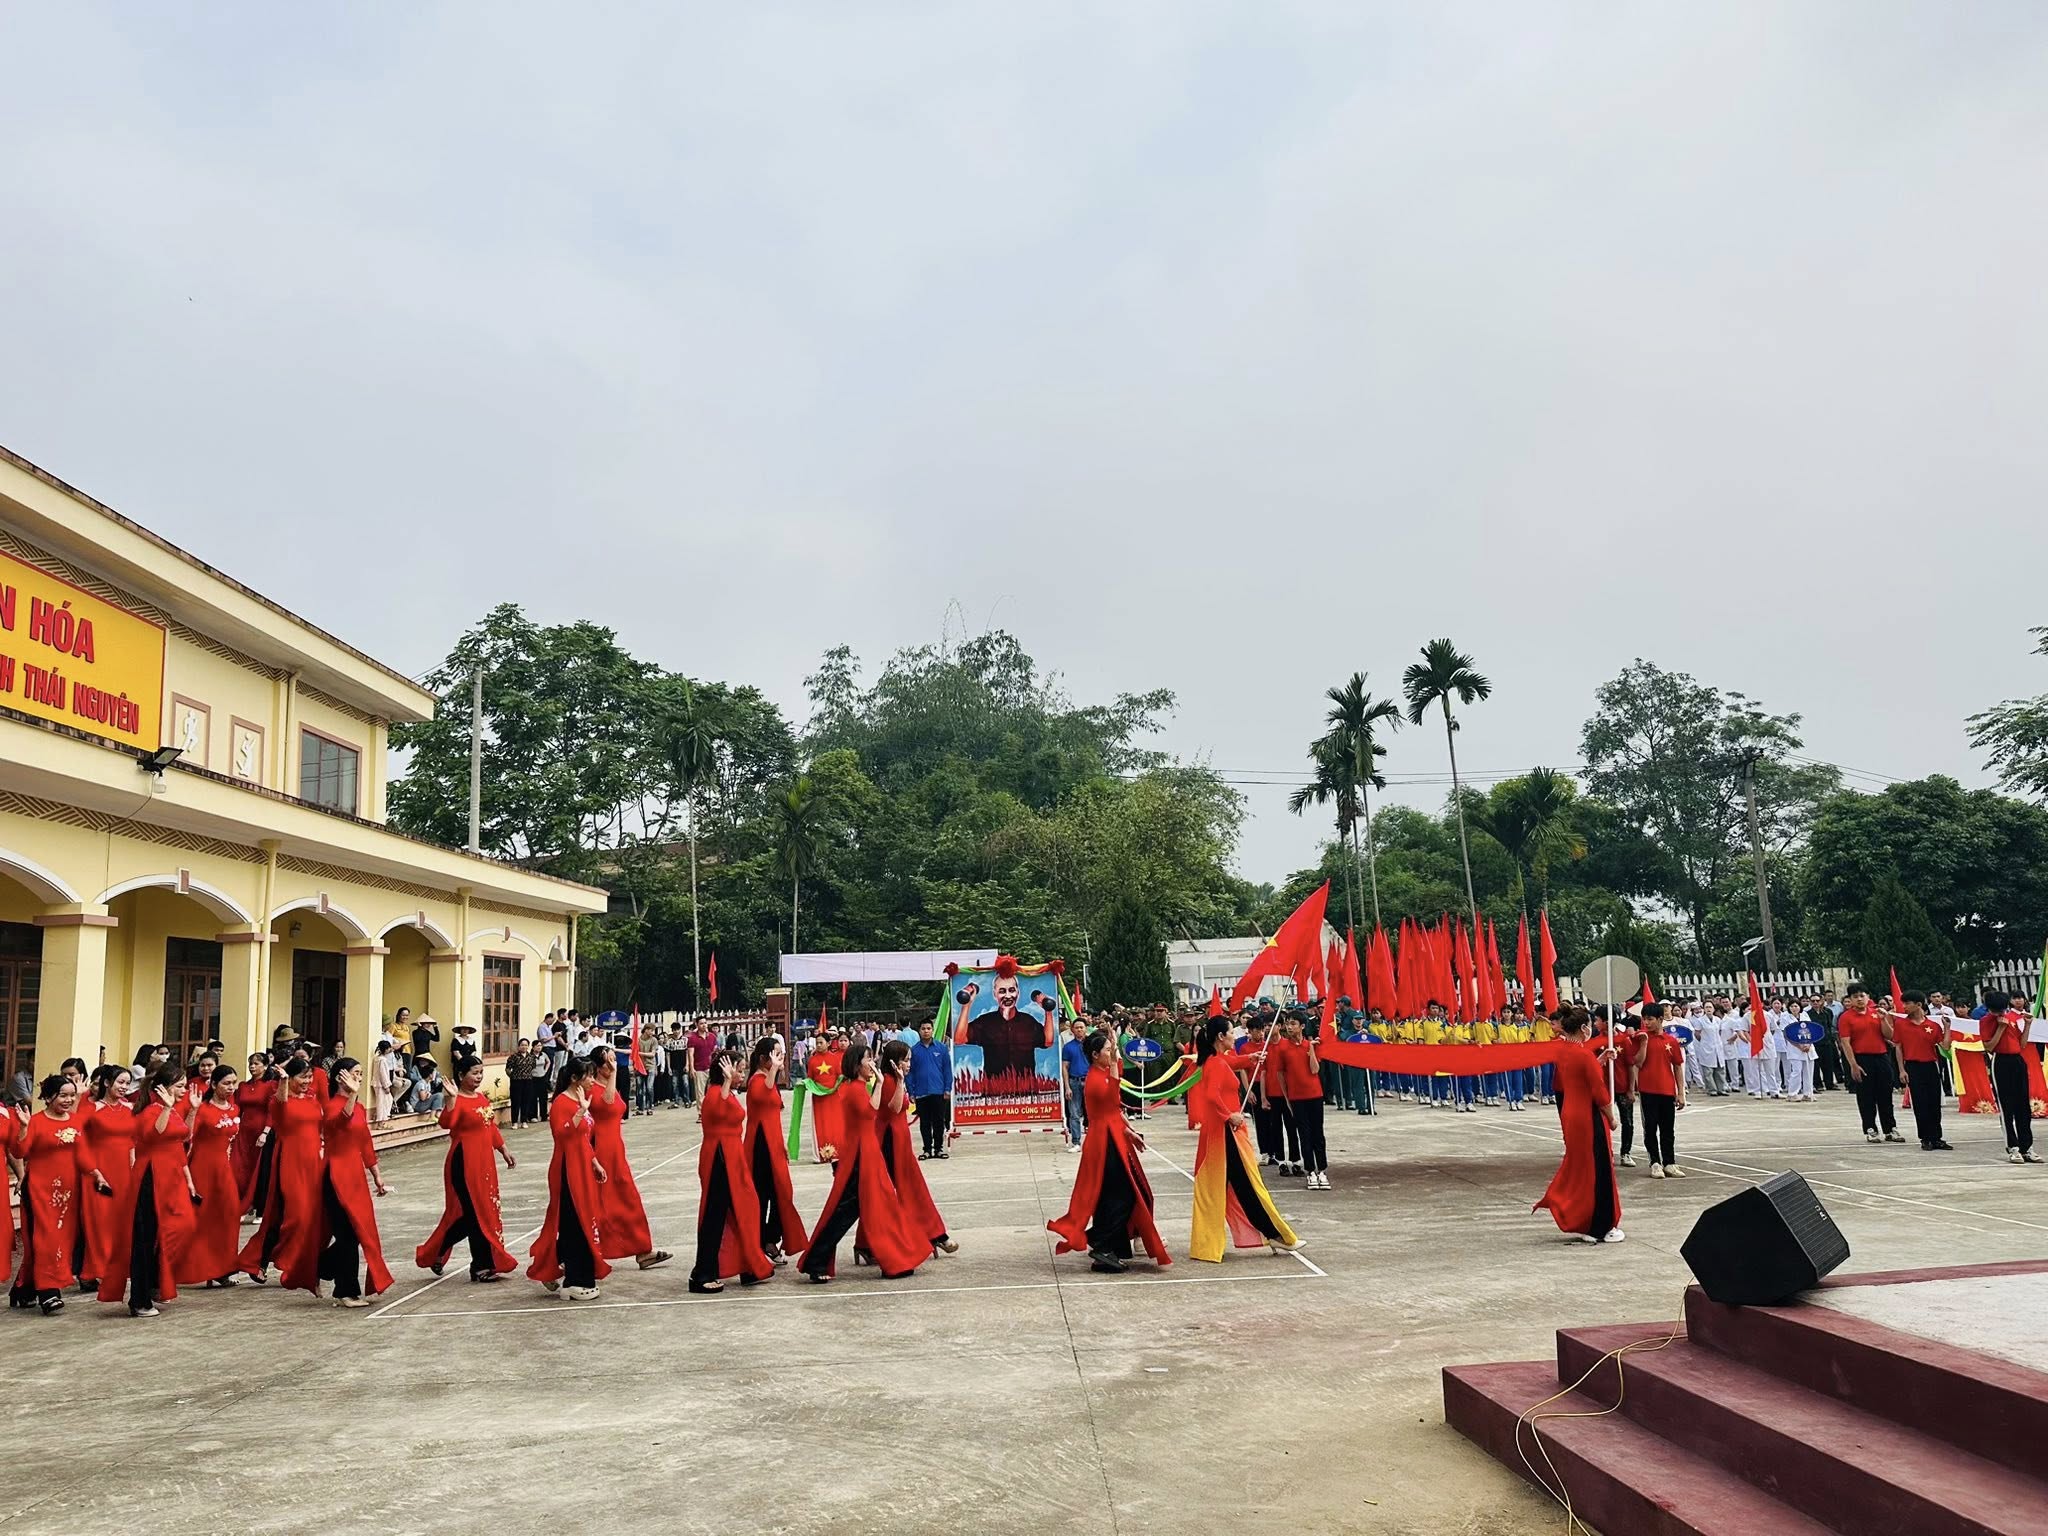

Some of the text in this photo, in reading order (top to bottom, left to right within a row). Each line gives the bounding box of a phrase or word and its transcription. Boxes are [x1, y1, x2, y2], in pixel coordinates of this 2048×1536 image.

[29, 596, 95, 664] HÓA
[23, 662, 66, 710] THÁI
[72, 681, 140, 735] NGUYÊN
